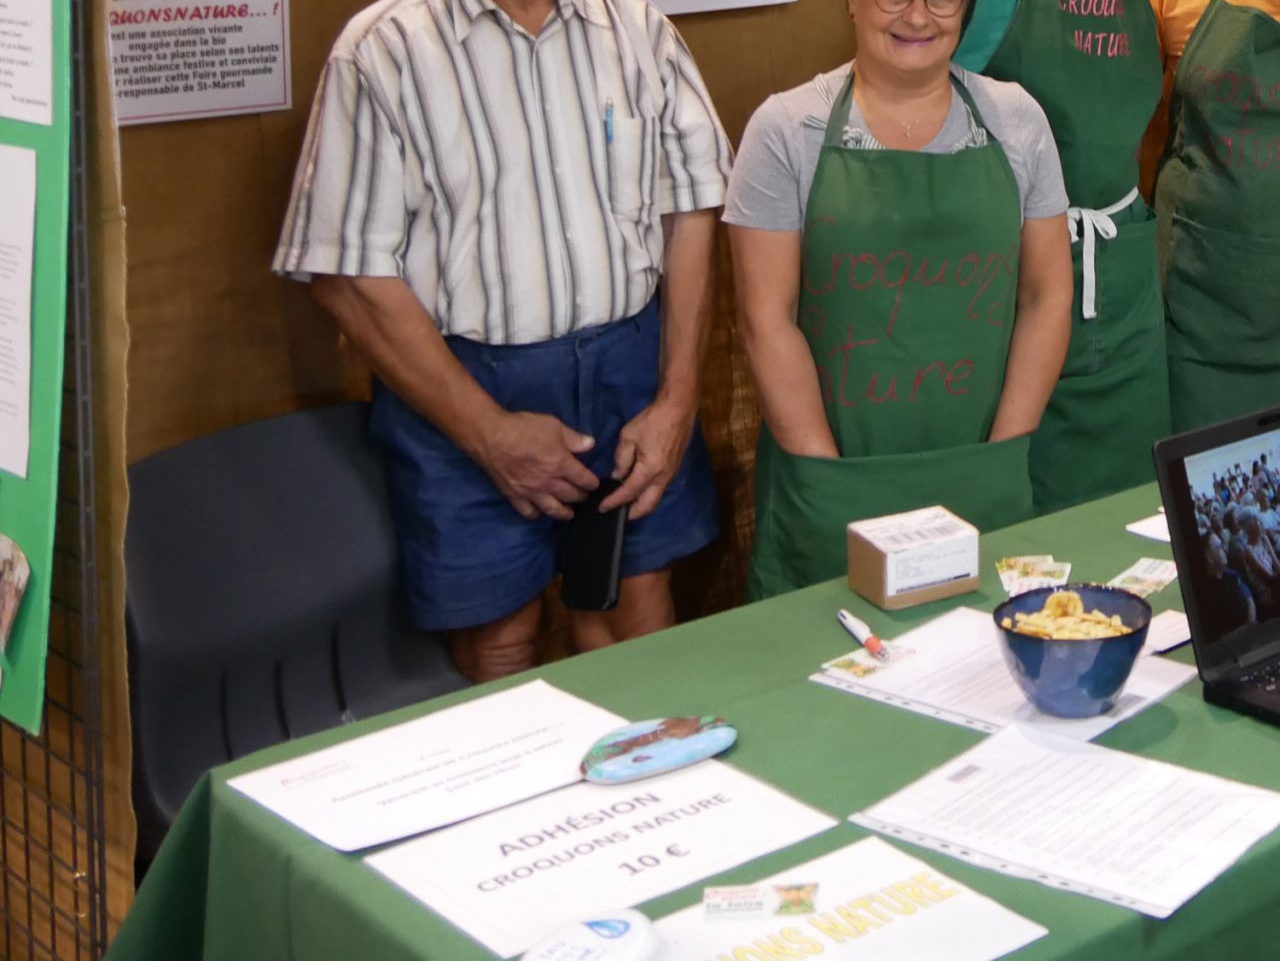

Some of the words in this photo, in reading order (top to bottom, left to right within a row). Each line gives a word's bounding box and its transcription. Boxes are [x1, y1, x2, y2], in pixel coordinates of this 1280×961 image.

[129, 31, 146, 40] une
[150, 26, 205, 39] association
[208, 24, 243, 35] vivante
[121, 51, 152, 63] trouve
[156, 52, 167, 61] sa
[171, 49, 196, 61] place
[200, 47, 226, 58] selon
[229, 47, 244, 56] ses
[248, 44, 279, 54] talents
[128, 38, 170, 53] engagée
[173, 38, 197, 48] dans
[200, 37, 208, 47] le
[212, 36, 226, 46] bio
[133, 61, 180, 74] ambiance
[183, 59, 215, 70] festive
[219, 58, 228, 67] et
[231, 55, 277, 66] conviviale
[123, 75, 162, 86] réaliser
[165, 72, 189, 82] cette
[193, 70, 217, 80] Foire
[220, 67, 273, 80] gourmande
[183, 83, 194, 92] de
[198, 80, 245, 92] St-Marcel
[498, 792, 662, 857] ADHÉSION
[477, 830, 630, 892] CROQUONS
[633, 792, 732, 834] NATURE
[619, 854, 660, 876] 10
[666, 842, 691, 858] €
[808, 871, 961, 945] NATURE
